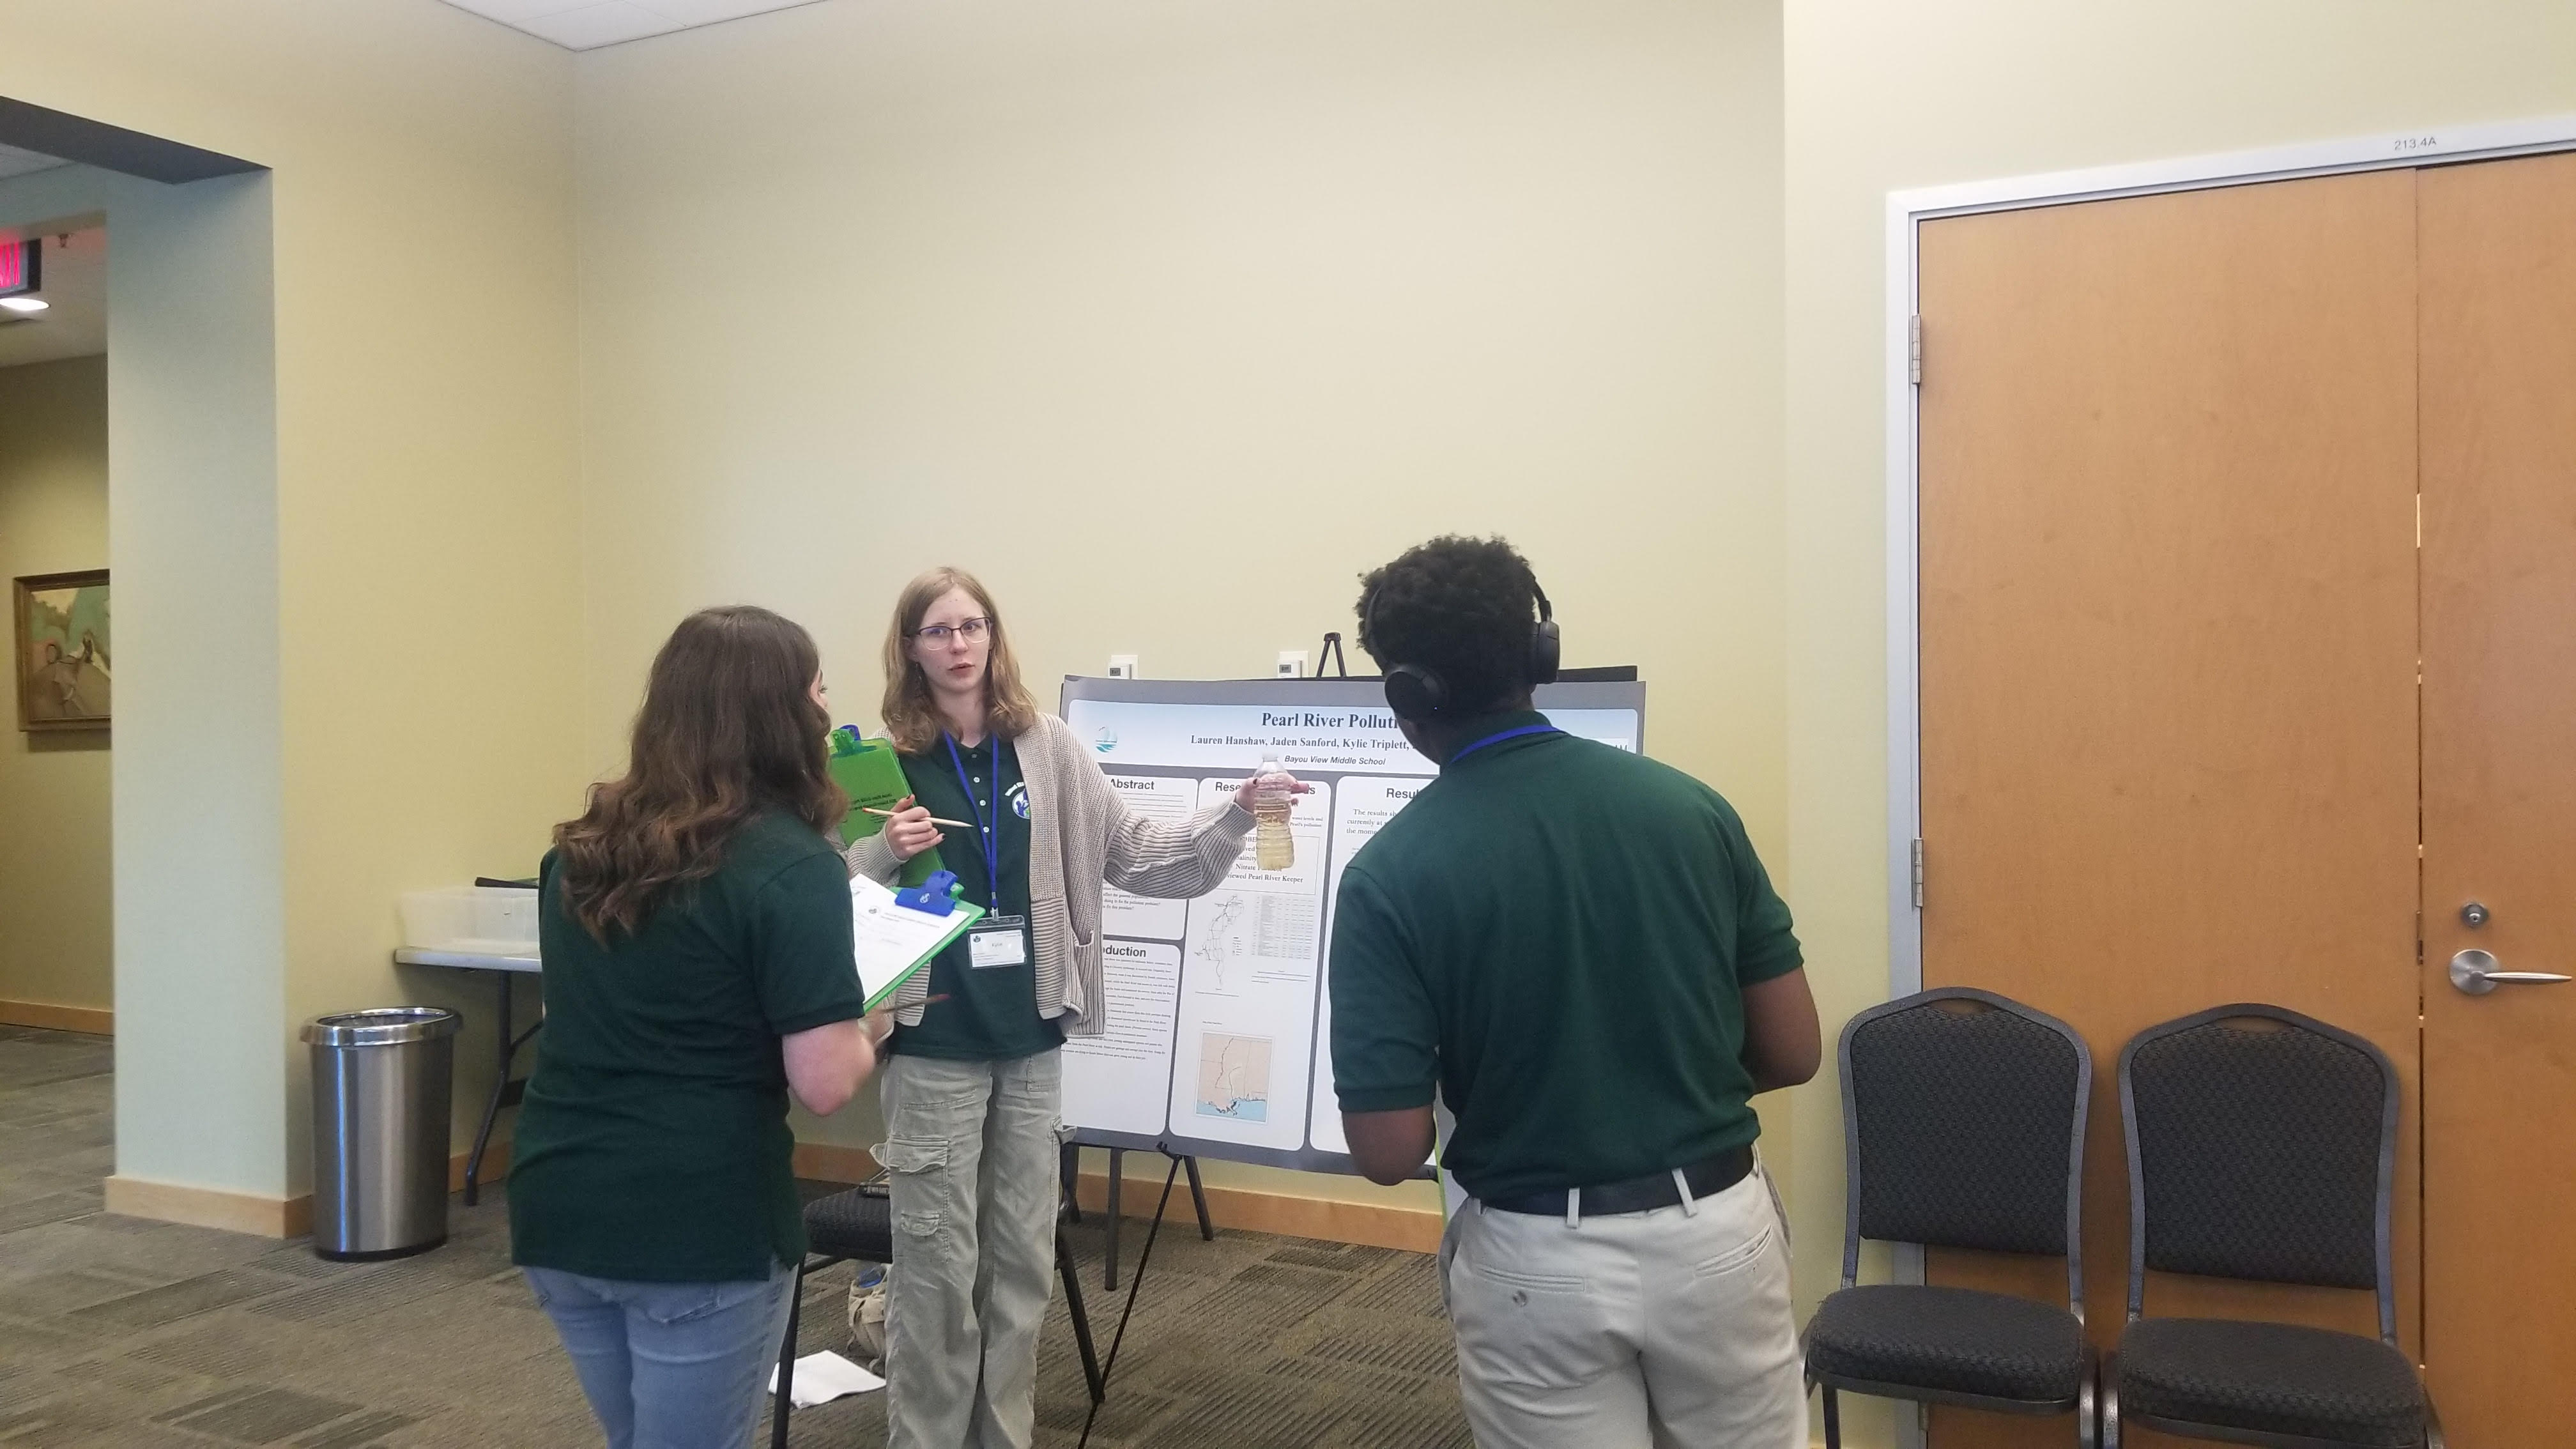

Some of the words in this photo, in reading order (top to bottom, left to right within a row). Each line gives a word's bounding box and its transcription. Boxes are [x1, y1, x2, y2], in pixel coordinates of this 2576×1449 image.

[2395, 136, 2437, 151] 213.4A
[1262, 712, 1299, 727] Pearl
[1303, 713, 1344, 728] River
[1191, 735, 1223, 745] Lauren
[1225, 736, 1268, 746] Hanshaw,
[1270, 737, 1297, 746] Jaden
[1300, 737, 1339, 748] Sanford,
[1342, 739, 1368, 749] Kylie
[1370, 739, 1409, 751] Triplett,
[1284, 755, 1308, 763] Bayou
